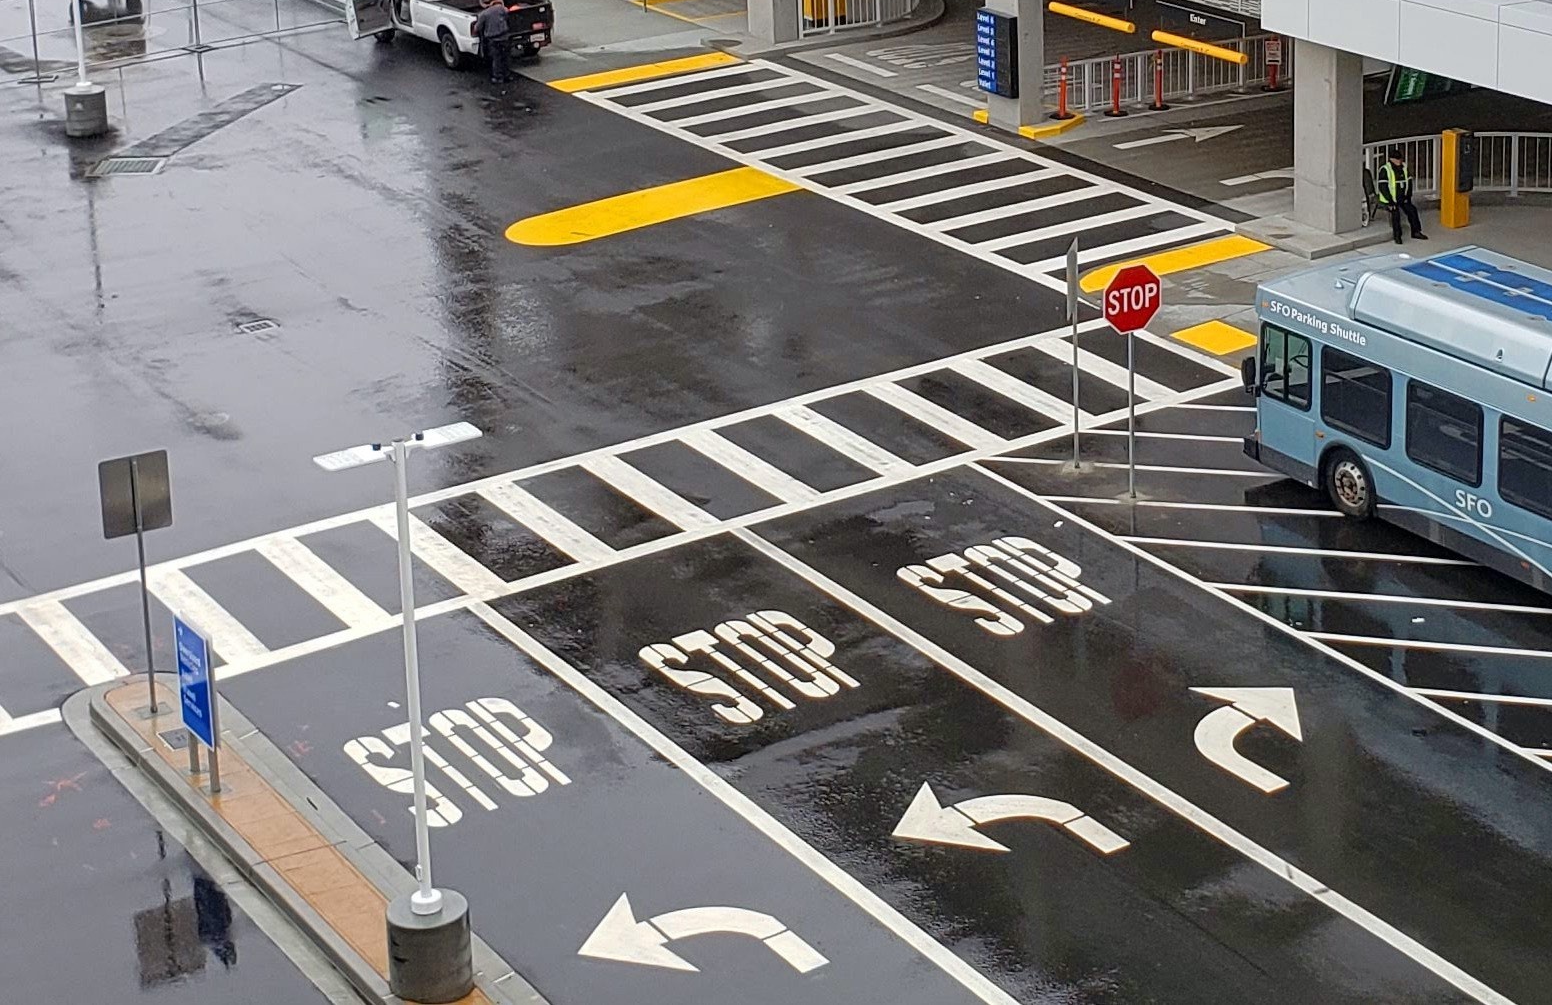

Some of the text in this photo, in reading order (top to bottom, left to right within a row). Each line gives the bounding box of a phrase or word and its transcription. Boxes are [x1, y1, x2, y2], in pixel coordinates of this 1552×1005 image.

[1189, 13, 1207, 25] Enter
[1108, 283, 1158, 316] STOP
[1270, 300, 1366, 346] SFO Parking Shuttle
[1455, 489, 1492, 518] SFO
[896, 536, 1112, 636] STOP
[638, 609, 861, 725] STOP
[342, 697, 572, 828] STOP
